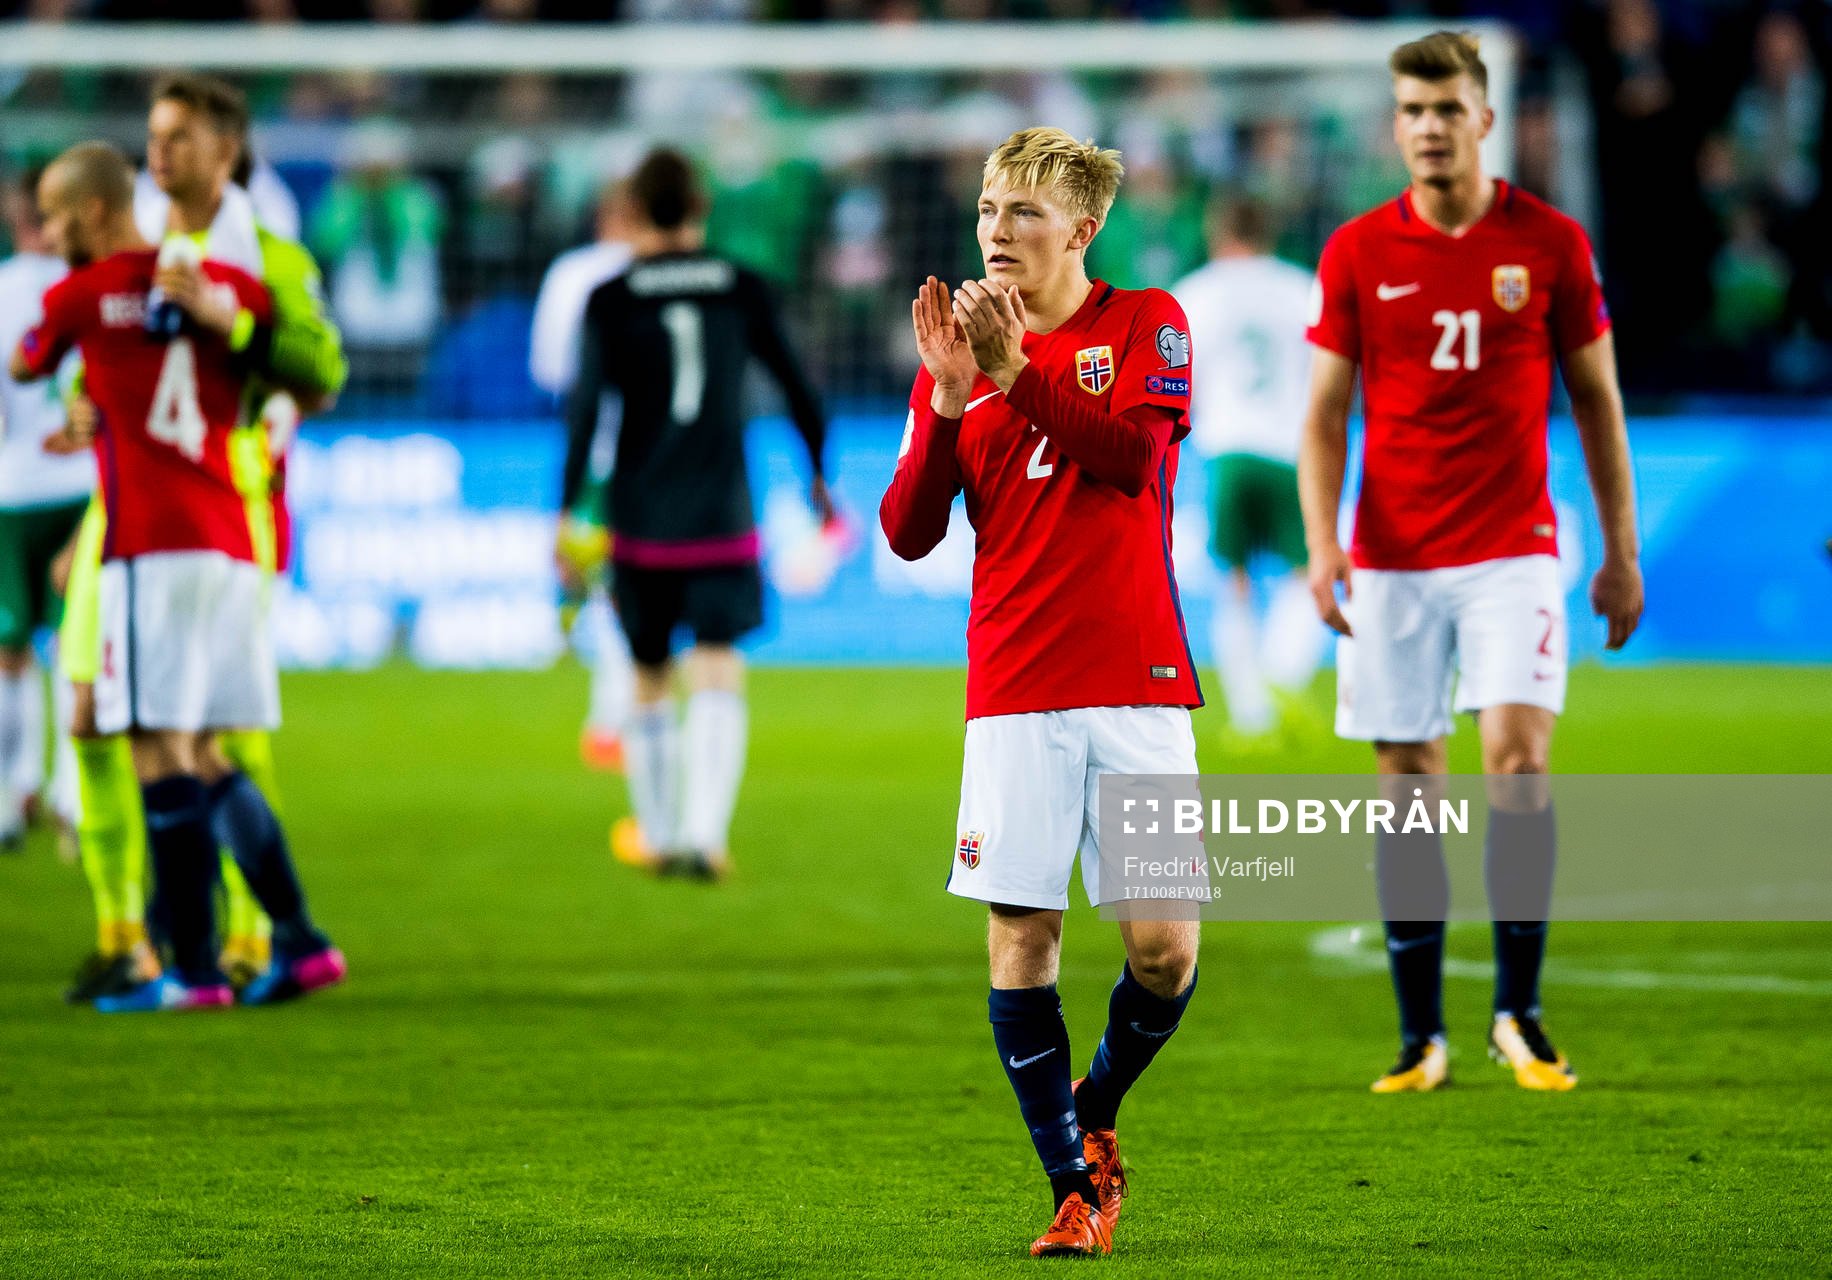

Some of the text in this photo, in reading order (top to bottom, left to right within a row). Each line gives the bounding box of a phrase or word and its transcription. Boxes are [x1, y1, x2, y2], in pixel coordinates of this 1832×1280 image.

[660, 300, 705, 425] 1
[1430, 308, 1481, 371] 21
[145, 337, 208, 464] 4
[1535, 607, 1559, 656] 2
